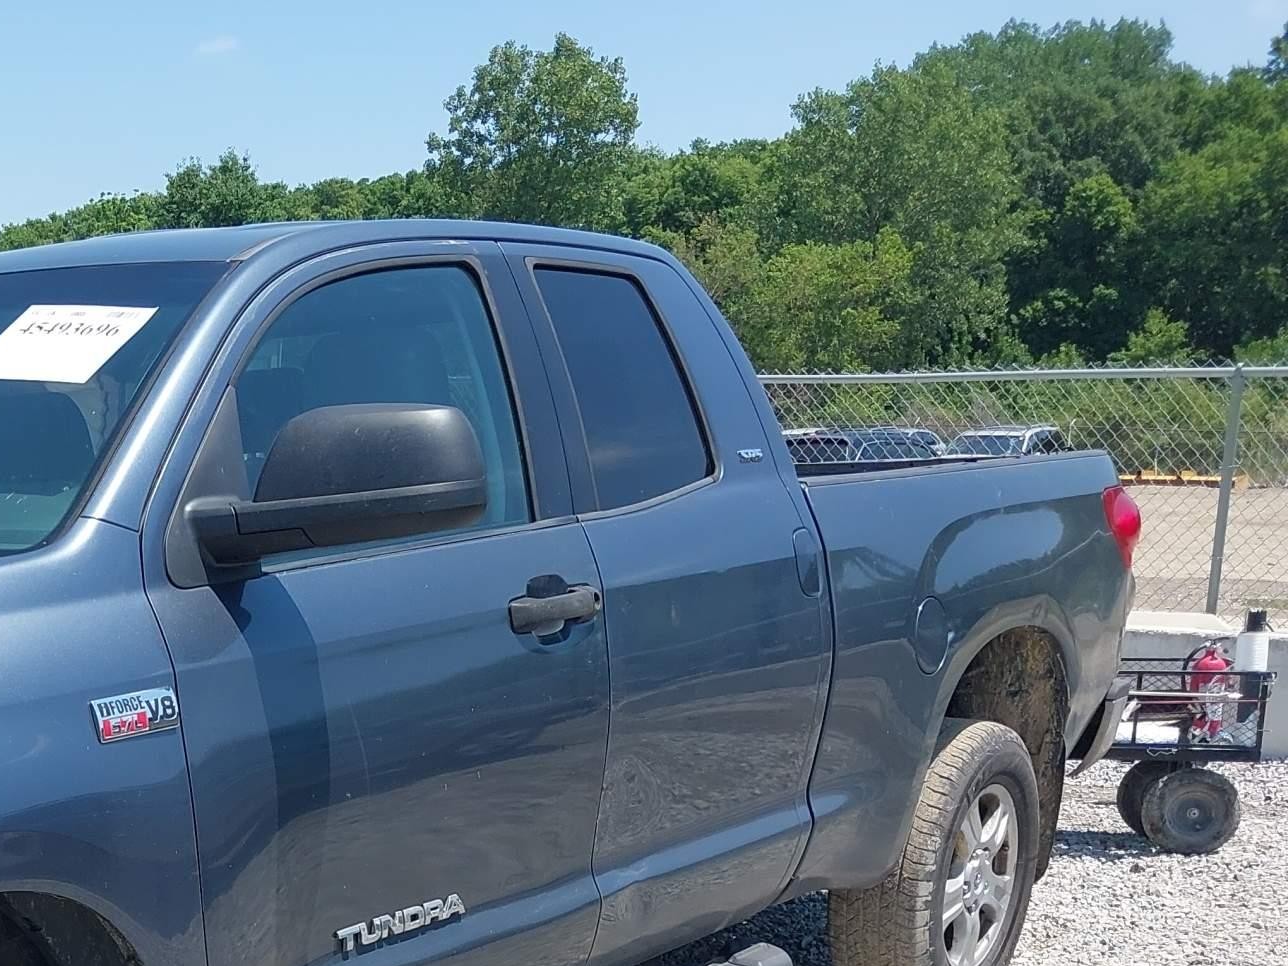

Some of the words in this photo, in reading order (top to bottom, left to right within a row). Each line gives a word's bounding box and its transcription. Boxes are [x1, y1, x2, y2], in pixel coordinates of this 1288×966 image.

[19, 321, 121, 337] 45493696
[145, 695, 177, 722] V8
[335, 893, 466, 952] TUNDRA
